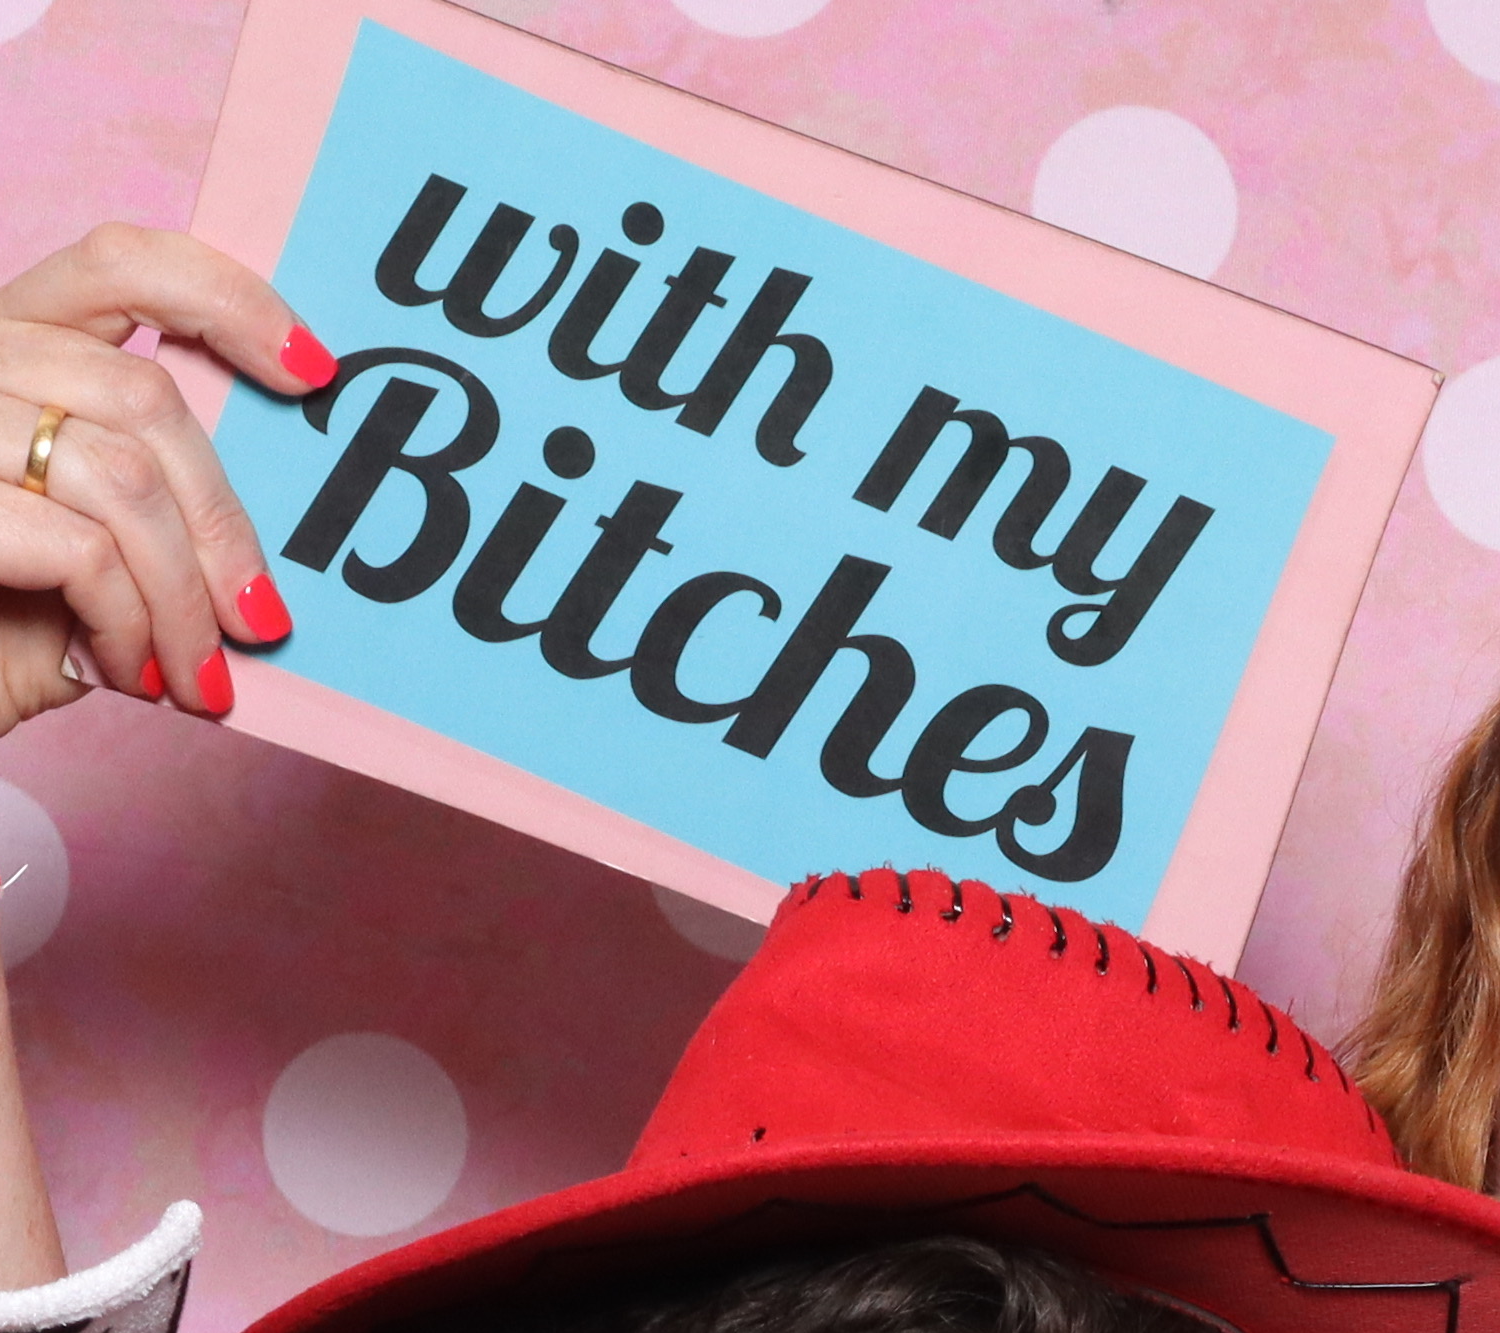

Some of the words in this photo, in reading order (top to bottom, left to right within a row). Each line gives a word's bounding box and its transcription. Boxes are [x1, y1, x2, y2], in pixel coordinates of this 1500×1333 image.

[279, 347, 1135, 882] Bitches
[373, 172, 834, 467] with
[851, 384, 1216, 666] my
